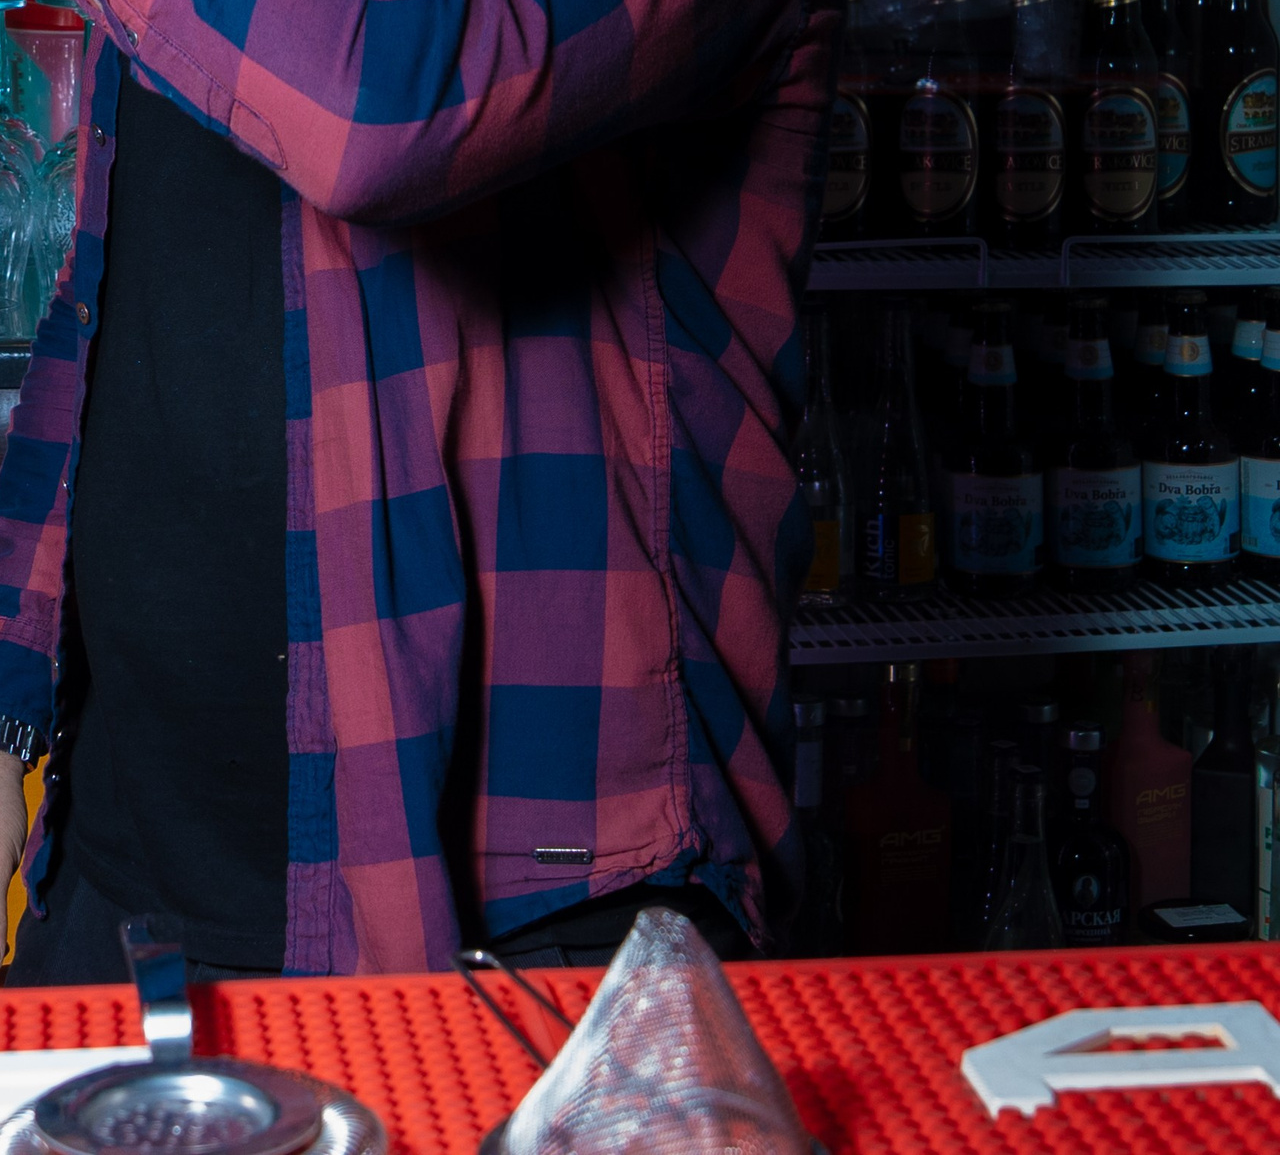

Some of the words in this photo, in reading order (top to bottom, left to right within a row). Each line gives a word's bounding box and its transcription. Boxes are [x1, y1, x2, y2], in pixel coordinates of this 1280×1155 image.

[1065, 488, 1088, 500] Dva
[1159, 482, 1181, 494] Dva
[1185, 482, 1221, 495] Bobřa
[964, 494, 988, 506] Dva
[883, 538, 895, 579] tonic
[1136, 783, 1186, 805] AMG
[880, 828, 942, 847] AMG
